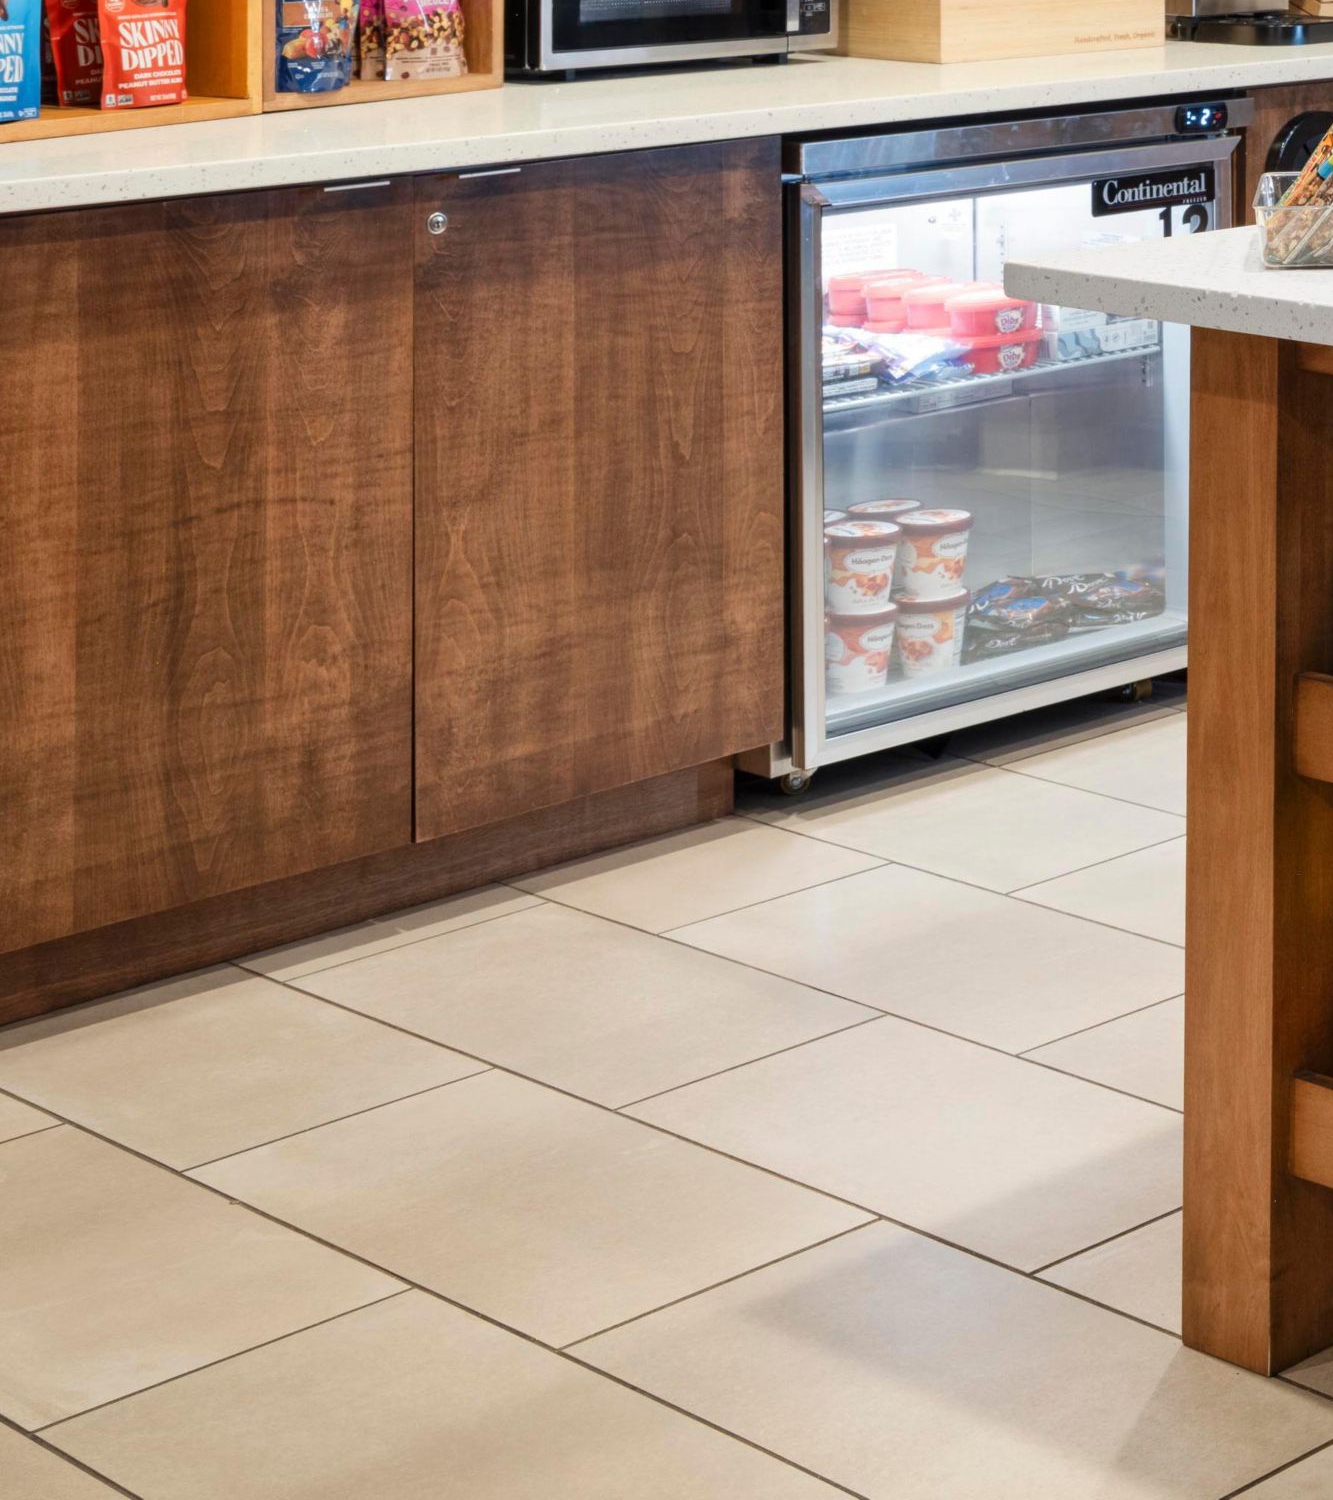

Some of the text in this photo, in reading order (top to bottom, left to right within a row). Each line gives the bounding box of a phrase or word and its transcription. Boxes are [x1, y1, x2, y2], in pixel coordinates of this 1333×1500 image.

[118, 19, 179, 48] SKINNY
[121, 40, 184, 71] DIPPED
[1102, 172, 1207, 205] Continental
[999, 314, 1020, 329] Dibs
[1000, 349, 1021, 364] Dibs
